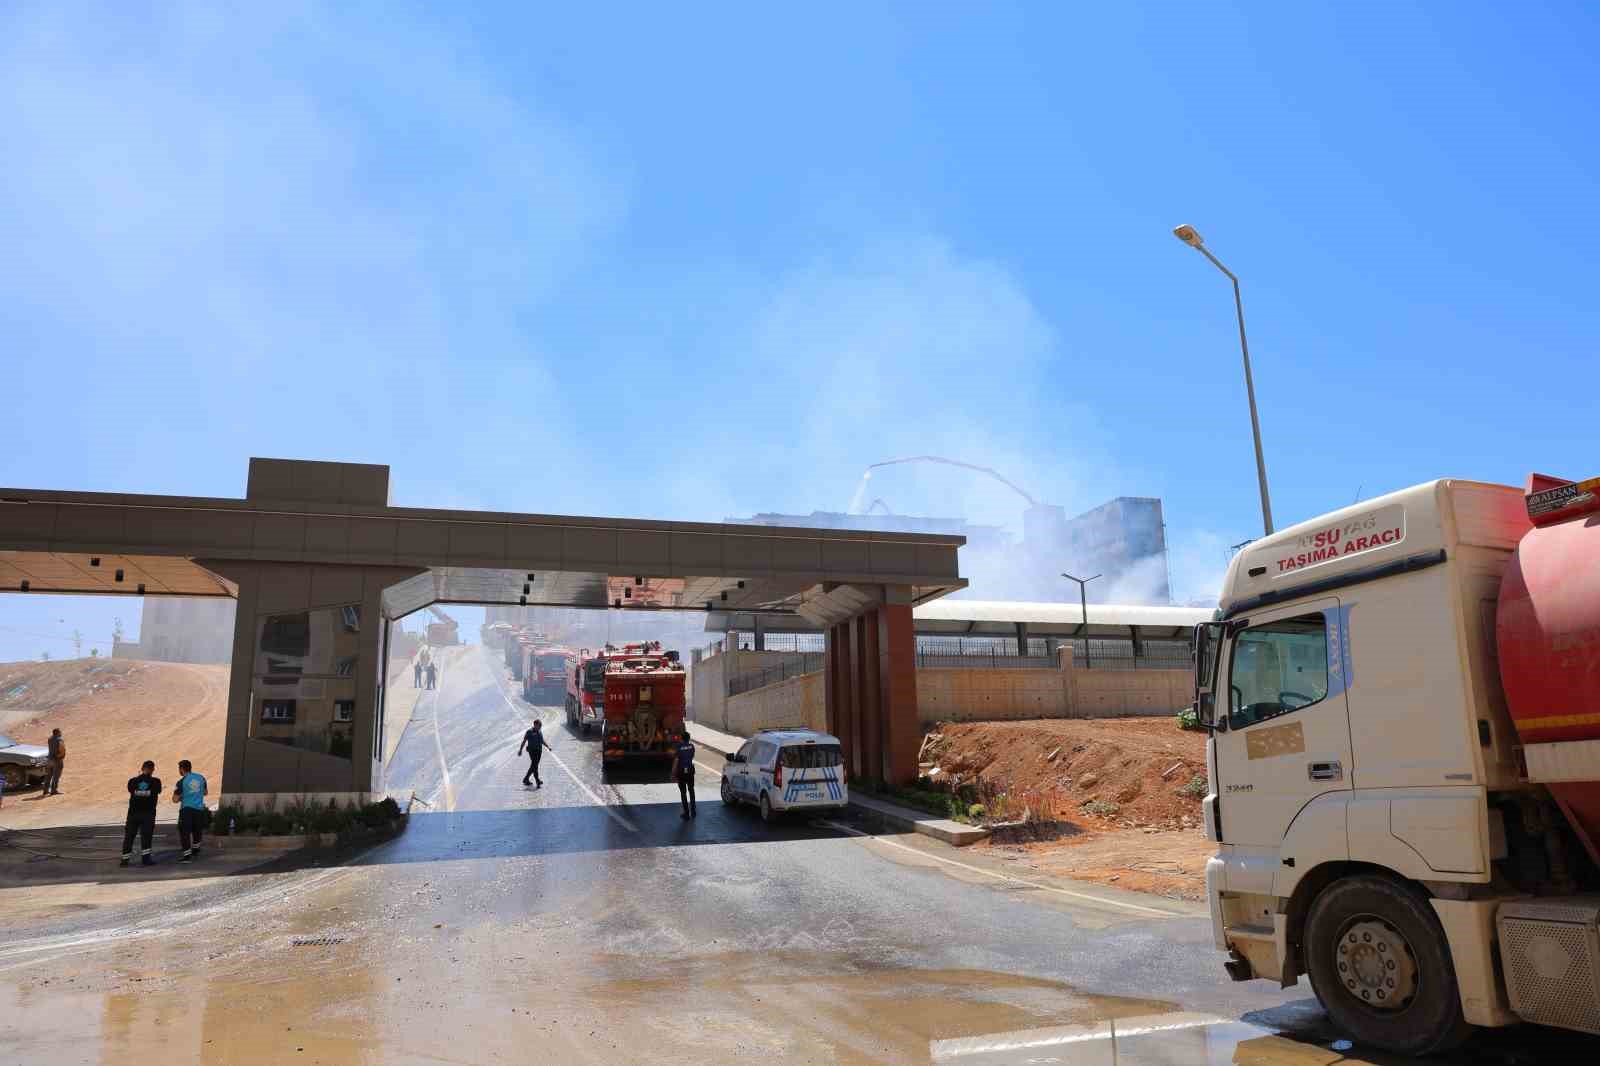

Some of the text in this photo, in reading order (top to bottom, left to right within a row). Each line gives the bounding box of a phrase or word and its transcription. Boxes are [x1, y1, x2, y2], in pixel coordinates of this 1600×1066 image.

[1277, 528, 1400, 571] TAŞIMA ARACI
[1314, 527, 1340, 548] SU
